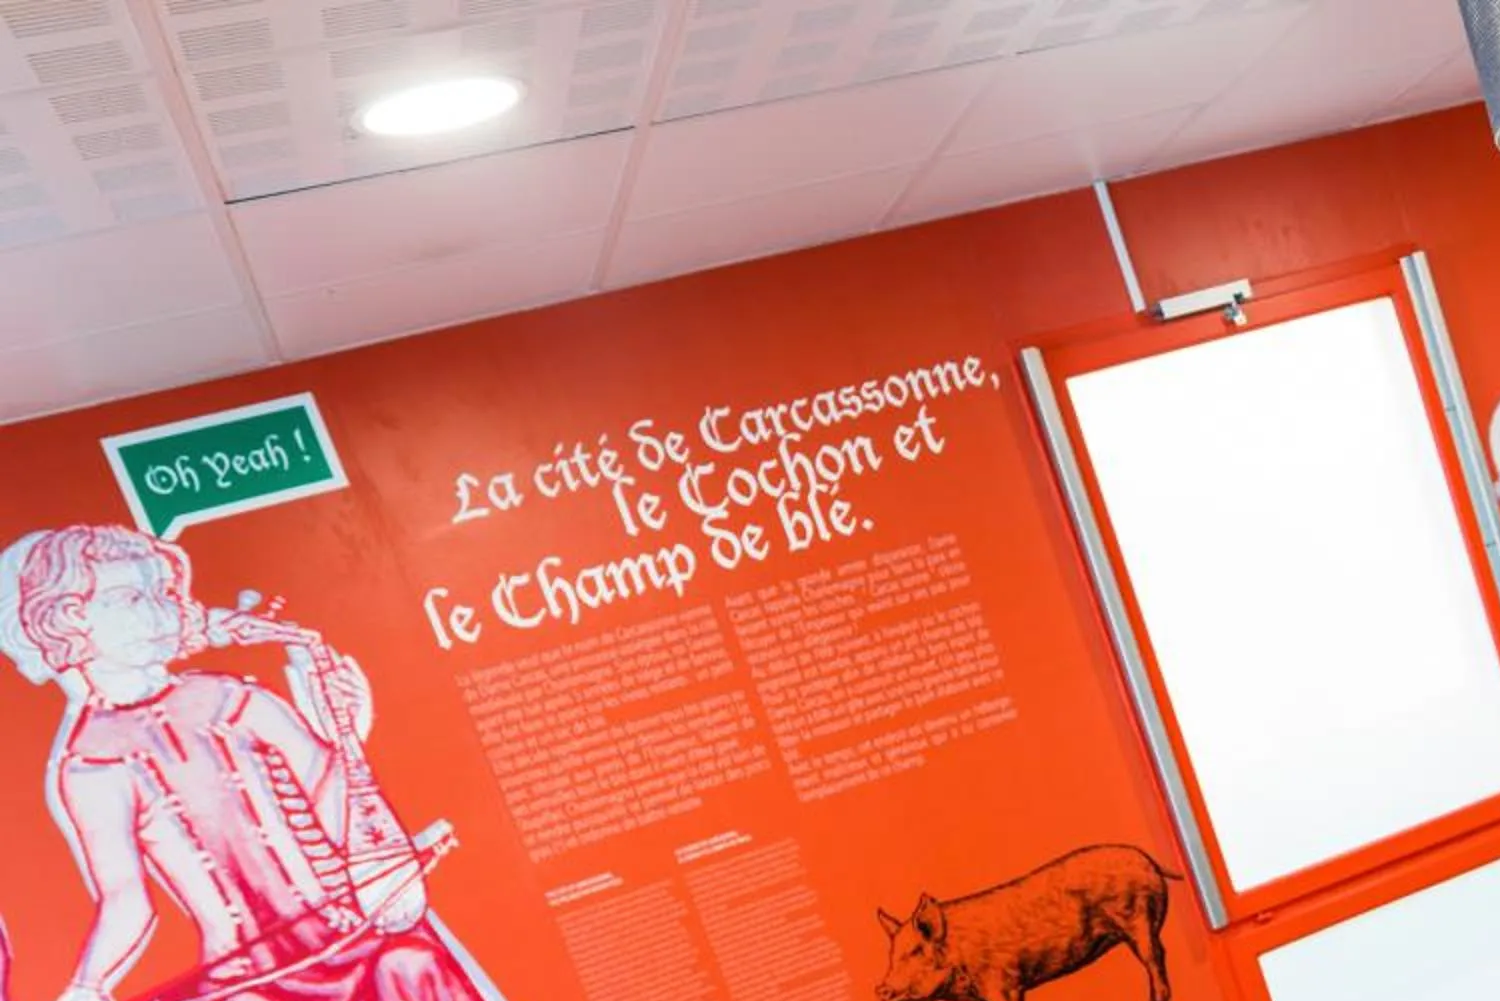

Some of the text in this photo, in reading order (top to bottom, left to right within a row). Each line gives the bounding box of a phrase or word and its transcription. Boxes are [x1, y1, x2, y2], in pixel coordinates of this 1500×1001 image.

[144, 428, 312, 495] Oh Yeah !
[451, 357, 999, 526] La cité de Carcassonne,
[611, 405, 945, 537] le Cochon et
[422, 481, 874, 650] le Champ de blé.
